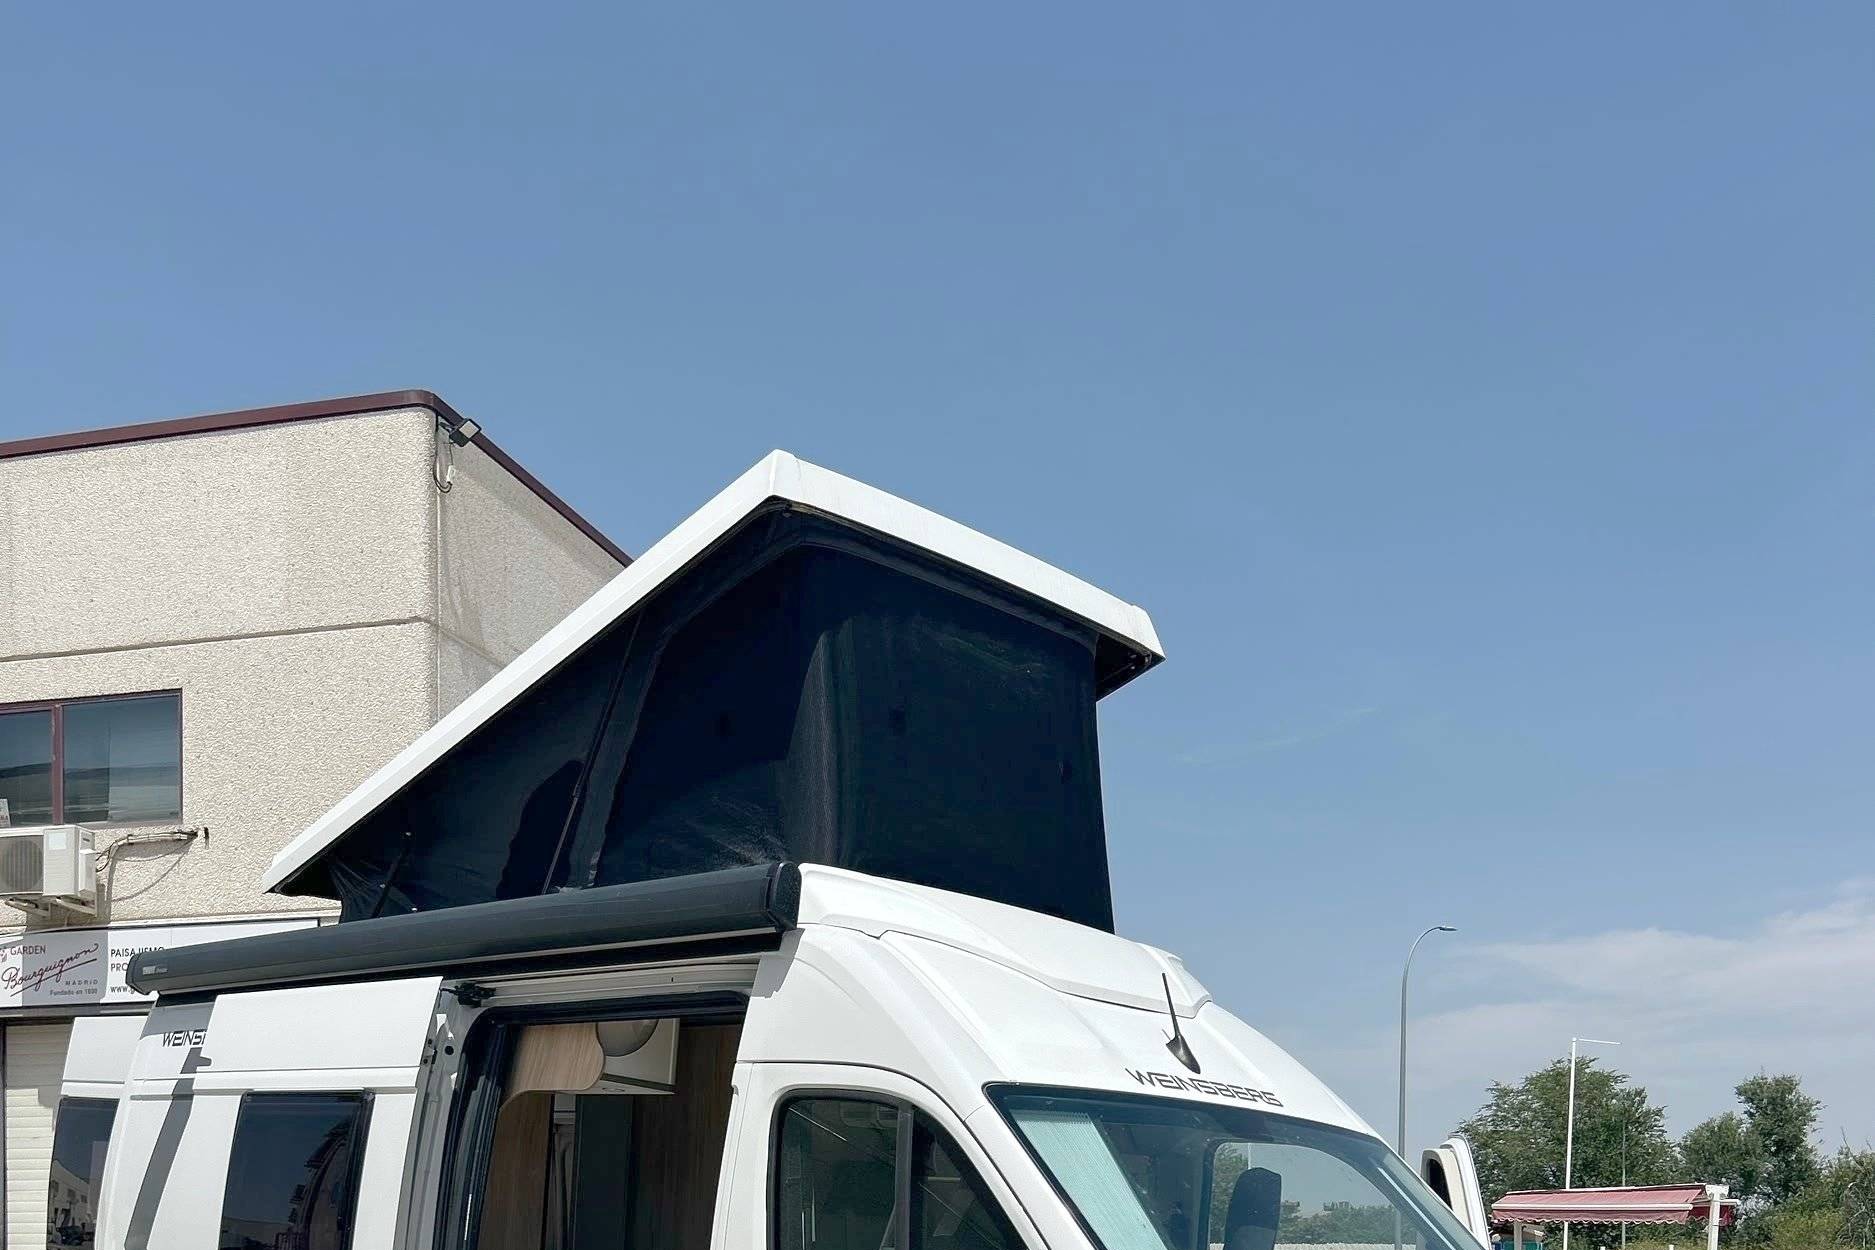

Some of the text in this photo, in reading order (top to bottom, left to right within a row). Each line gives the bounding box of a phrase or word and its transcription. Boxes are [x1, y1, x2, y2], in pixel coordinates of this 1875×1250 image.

[10, 945, 46, 956] GARDEN
[2, 943, 99, 992] Bourguignon
[162, 1029, 207, 1047] WEINS
[1125, 1067, 1284, 1107] WEINSBERG
